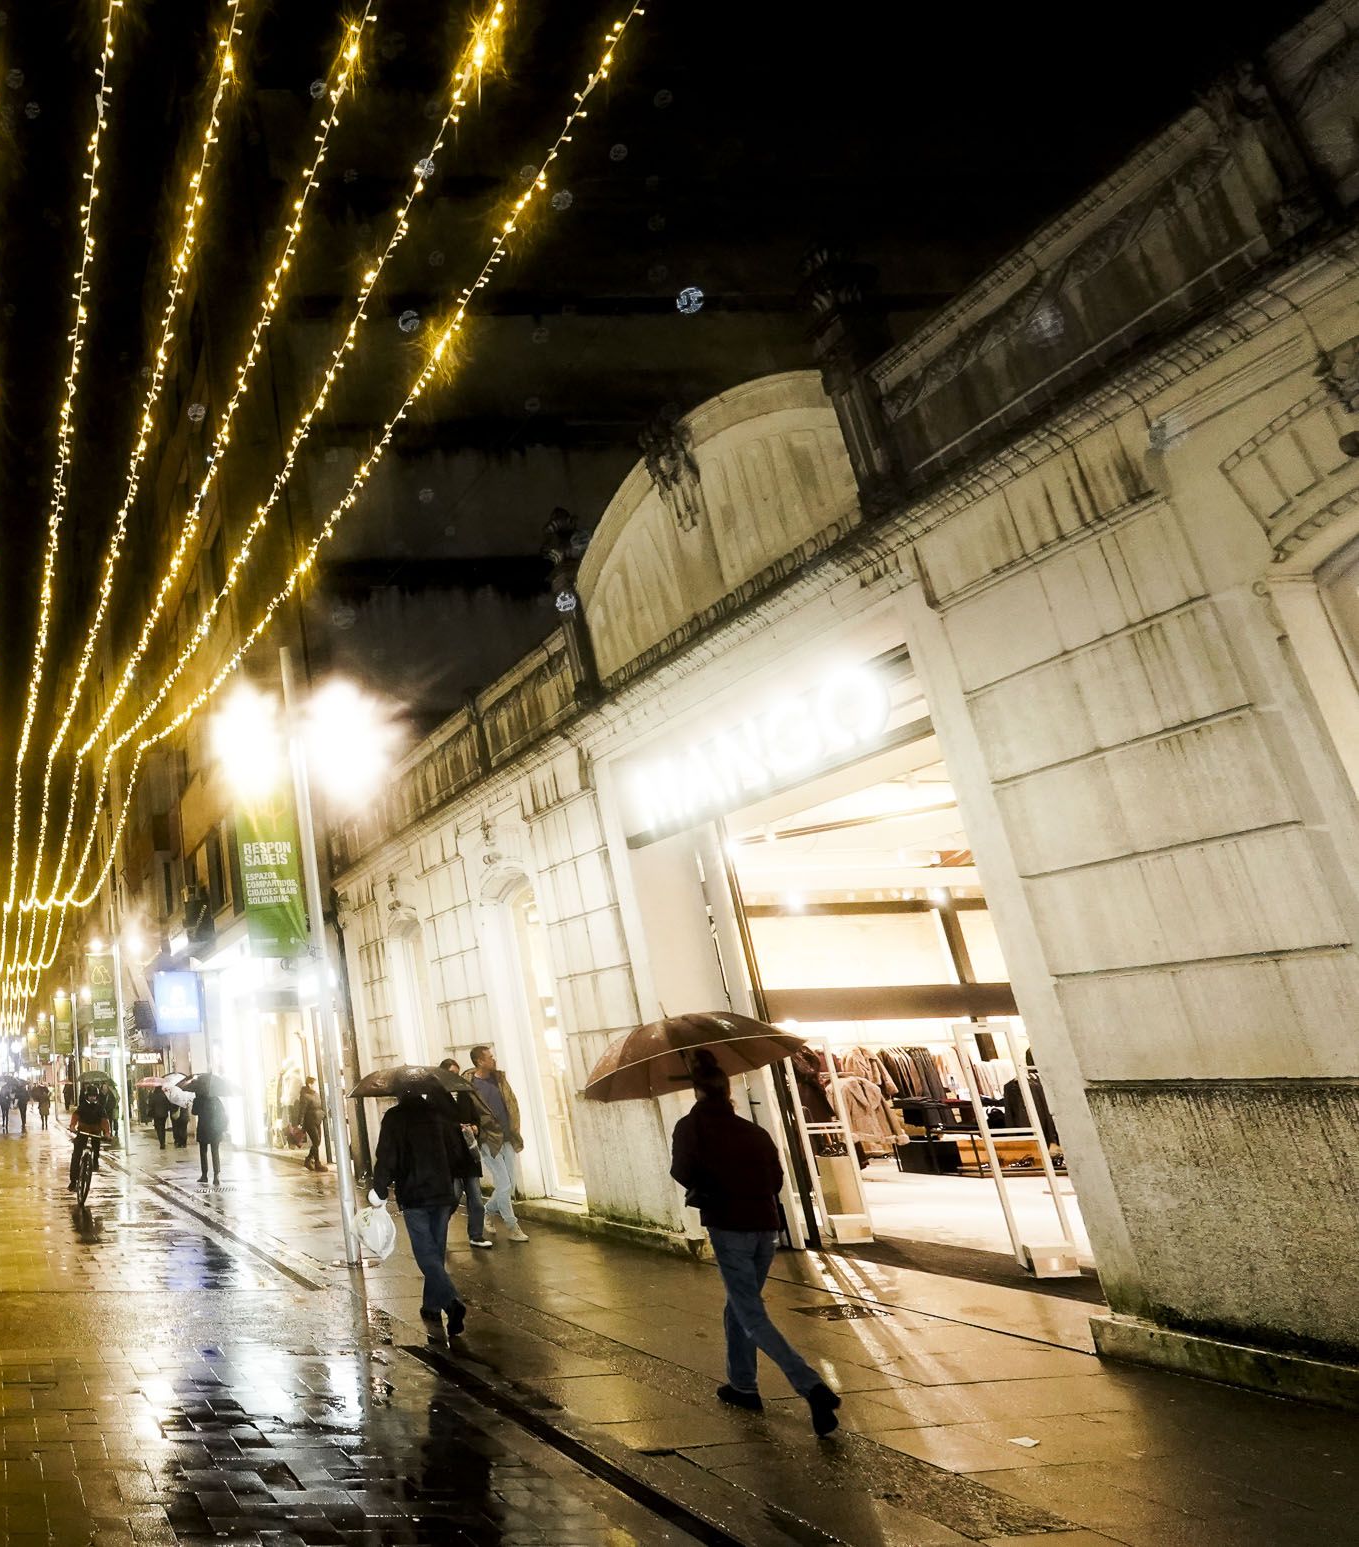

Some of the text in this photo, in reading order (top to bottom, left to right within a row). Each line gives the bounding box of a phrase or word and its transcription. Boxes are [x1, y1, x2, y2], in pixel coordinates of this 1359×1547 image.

[635, 667, 890, 830] MANGO
[243, 842, 291, 855] RESPON
[245, 872, 277, 881] ESPAZOS
[247, 887, 278, 897] CIDADES
